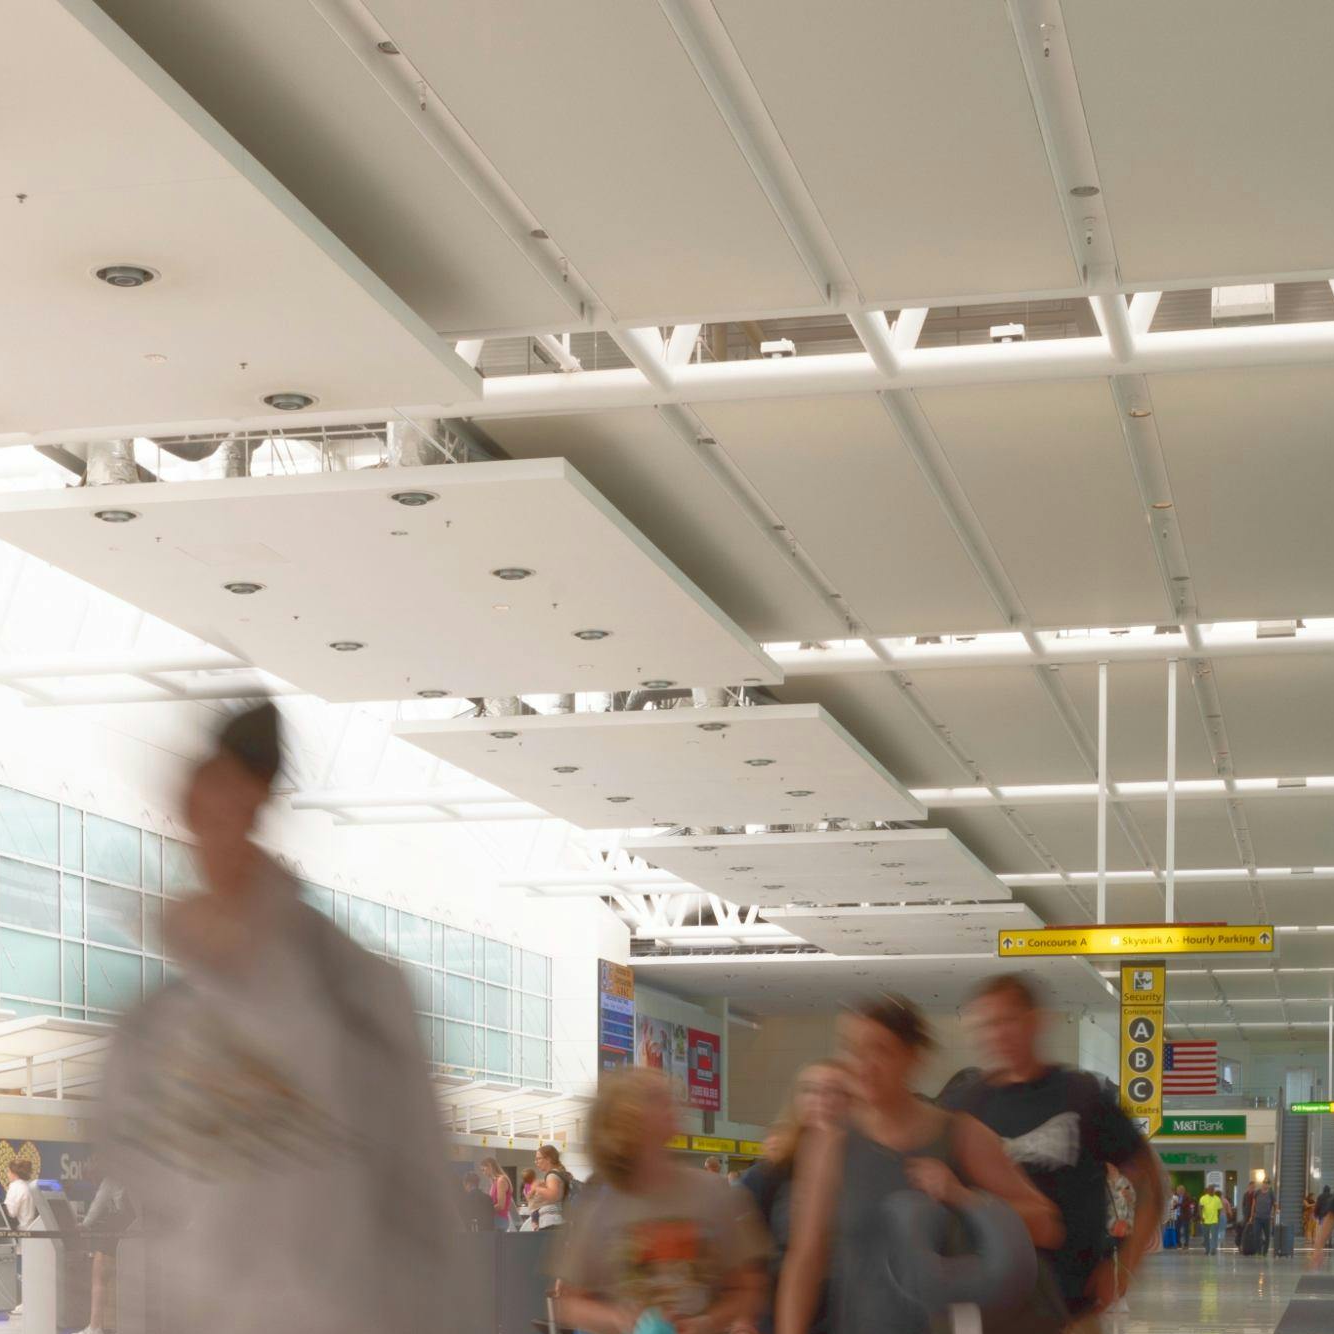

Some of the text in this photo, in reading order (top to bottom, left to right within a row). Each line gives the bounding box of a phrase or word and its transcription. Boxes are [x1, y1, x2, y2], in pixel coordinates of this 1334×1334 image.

[1028, 938, 1088, 948] Concourse A
[1123, 934, 1255, 948] Skywalk A Hourly Parking
[1124, 993, 1162, 1002] Security
[1134, 1022, 1149, 1038] A
[1135, 1052, 1147, 1067] B
[1133, 1082, 1146, 1098] C
[1173, 1120, 1224, 1131] M&T Bank
